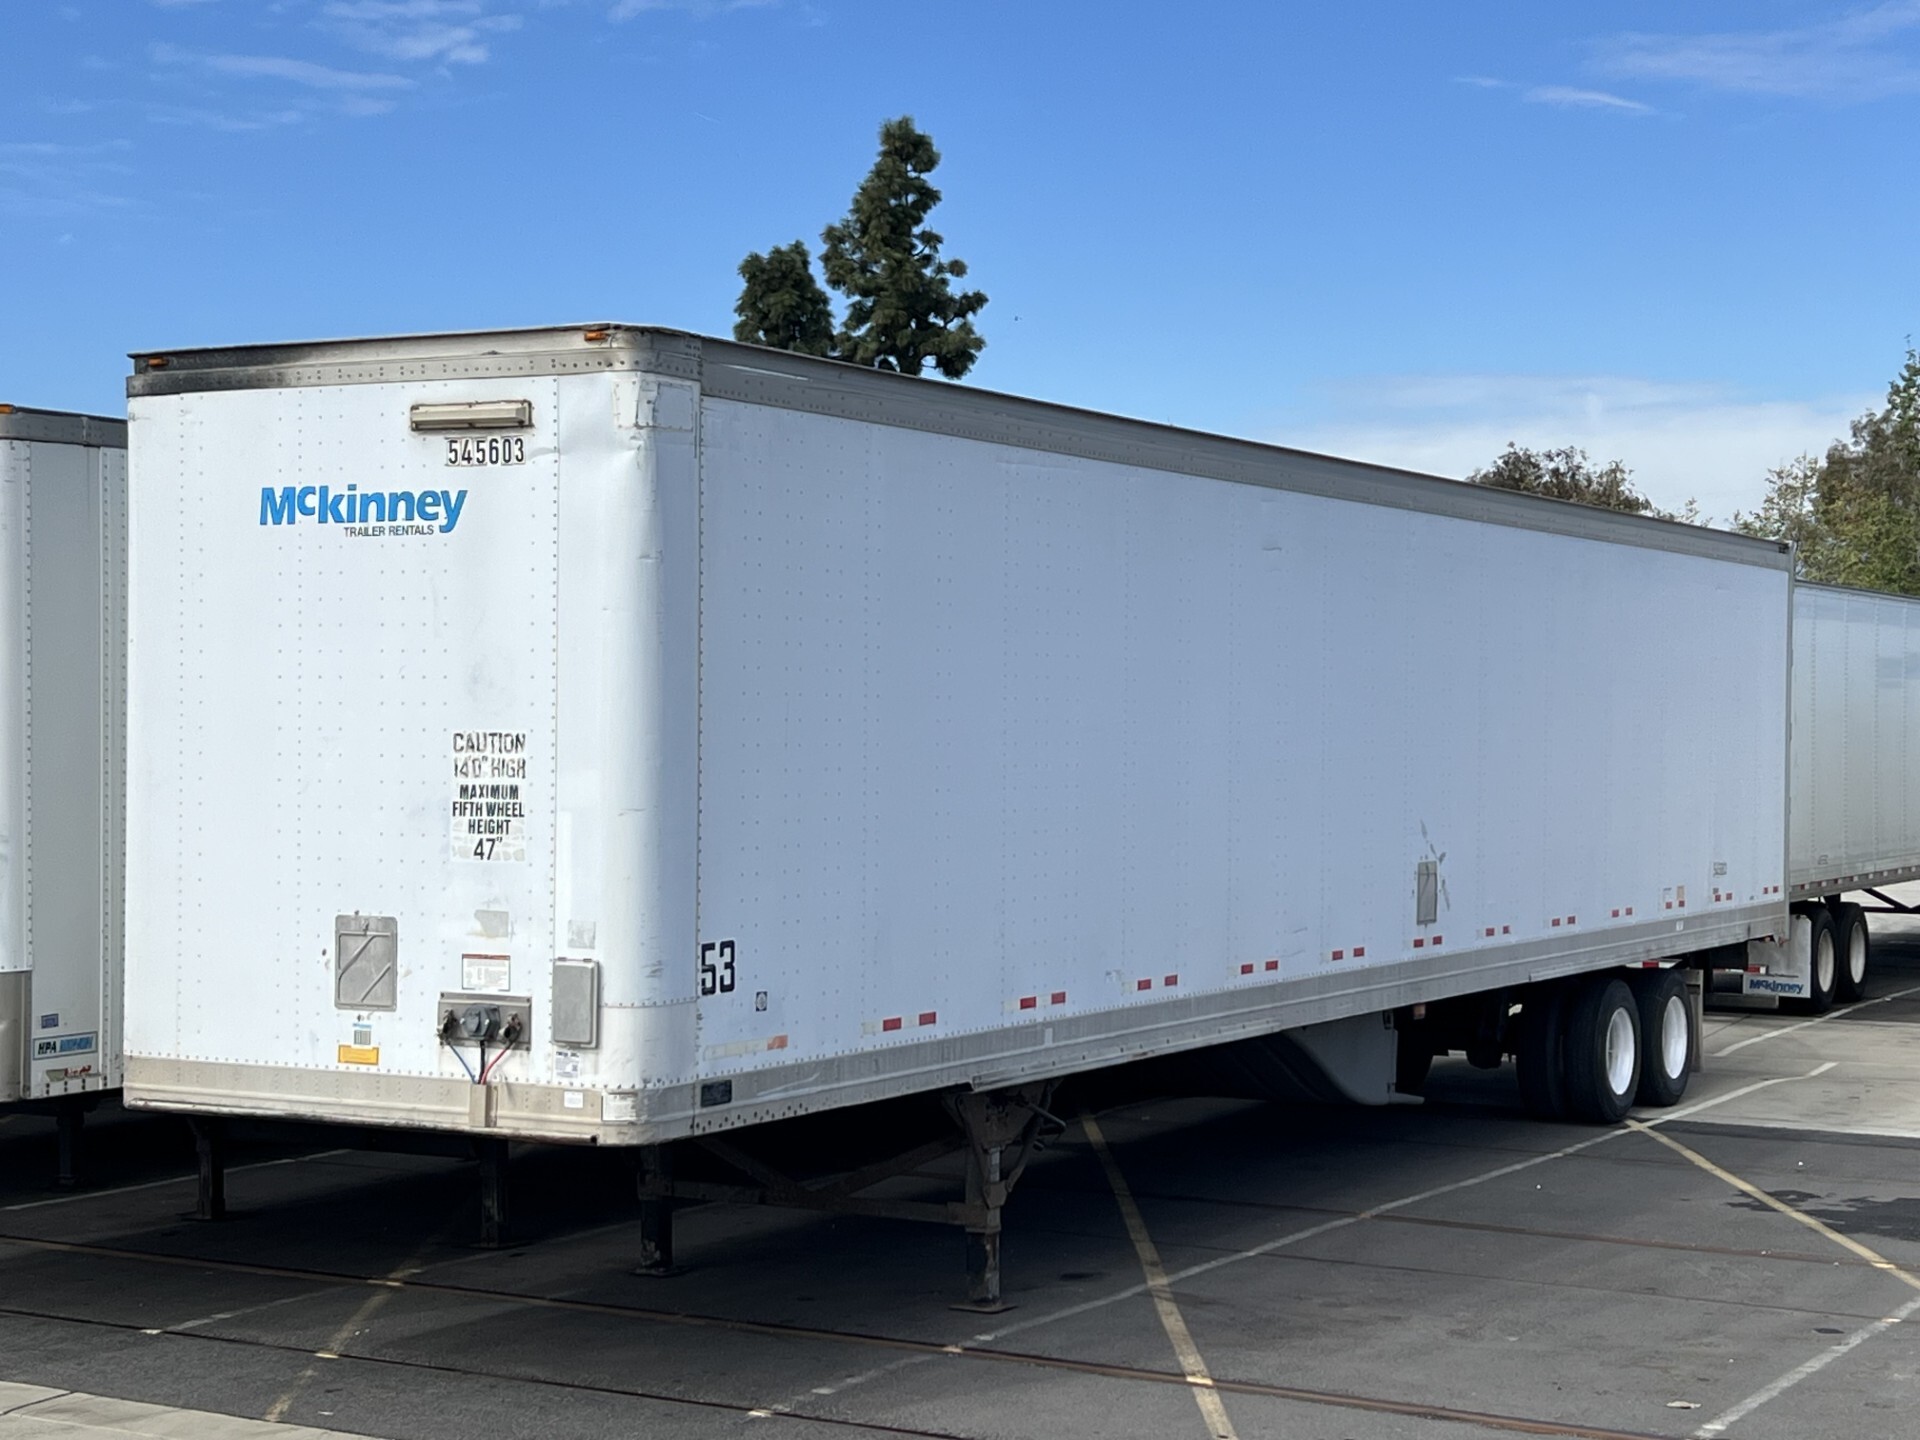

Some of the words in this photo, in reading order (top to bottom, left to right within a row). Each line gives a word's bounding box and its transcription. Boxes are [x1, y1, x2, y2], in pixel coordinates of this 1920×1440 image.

[448, 438, 525, 465] 545603
[344, 526, 386, 537] TRAILER
[388, 525, 434, 536] RENTALS
[452, 732, 526, 754] CAUTION
[491, 758, 526, 779] HIGH
[459, 784, 519, 799] MAXIMUM
[452, 801, 483, 817] FIFTH
[486, 802, 525, 817] WHEEL
[468, 819, 511, 835] HEIGHT
[701, 940, 735, 996] 53
[38, 1041, 57, 1055] HPA
